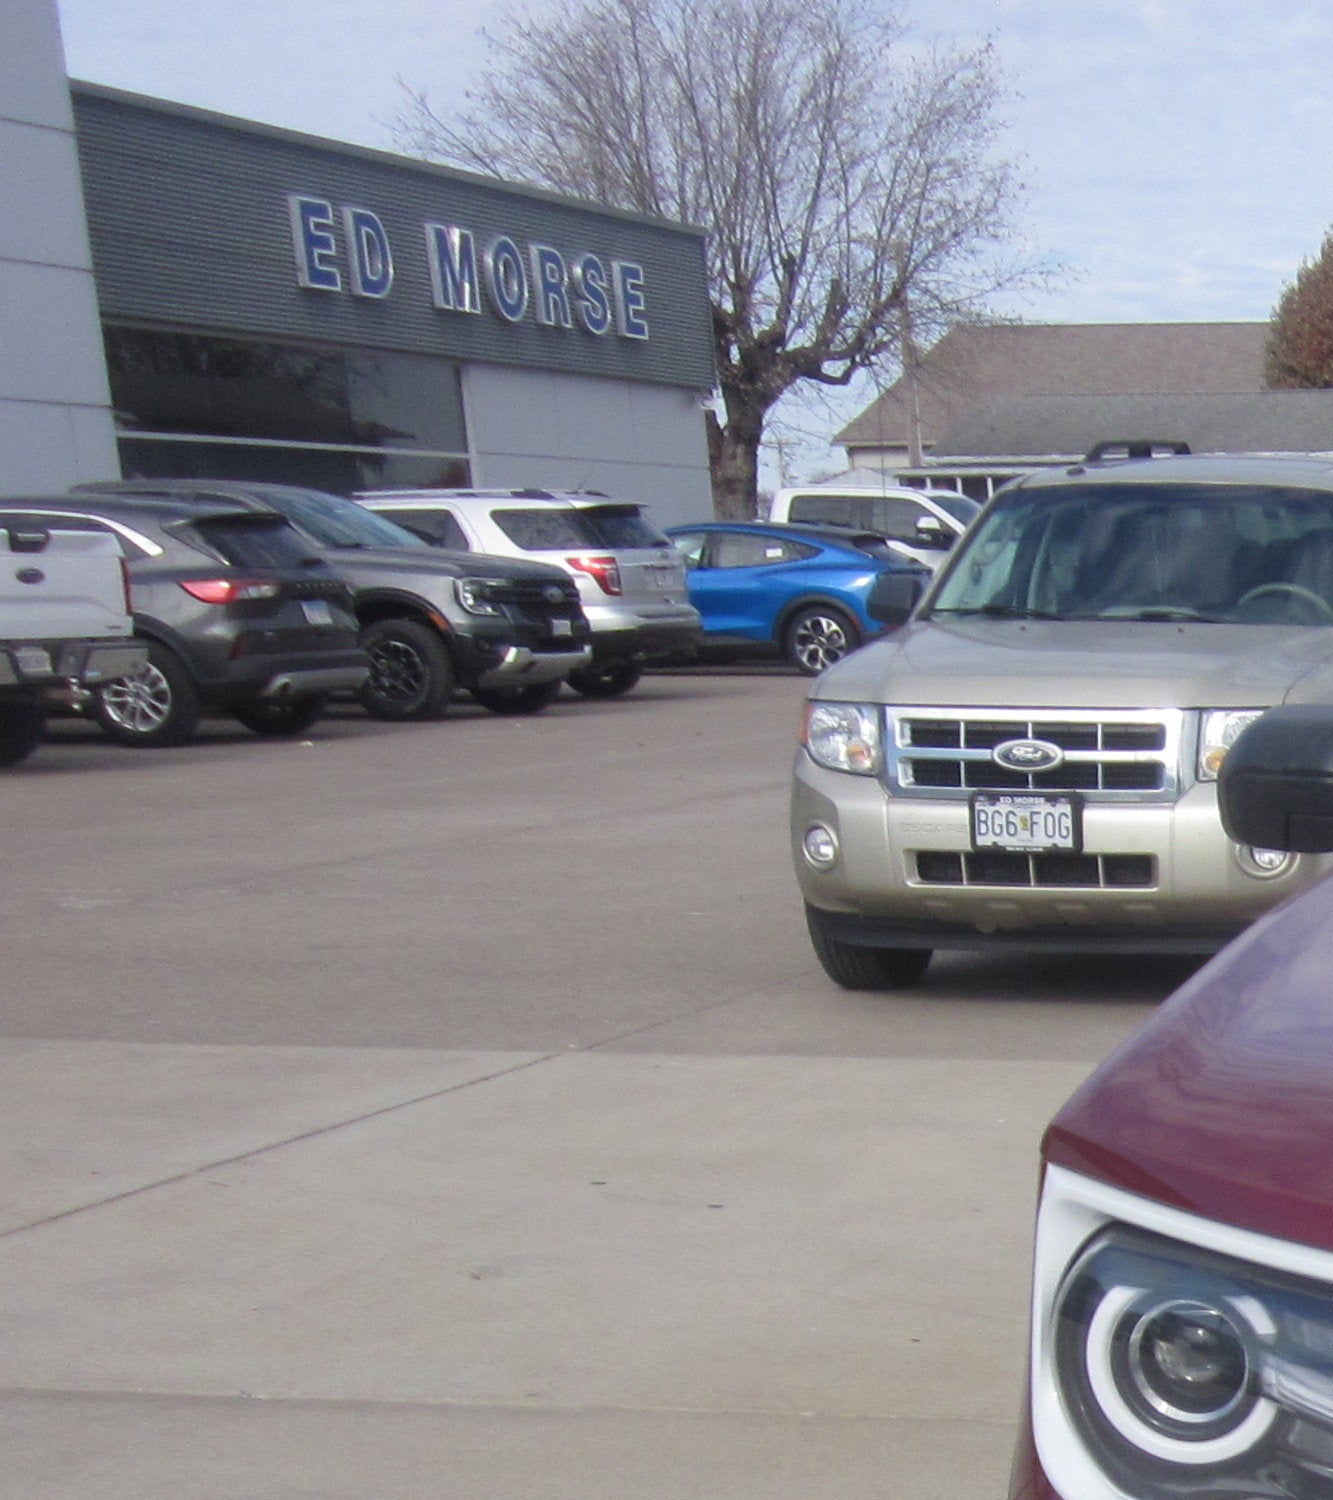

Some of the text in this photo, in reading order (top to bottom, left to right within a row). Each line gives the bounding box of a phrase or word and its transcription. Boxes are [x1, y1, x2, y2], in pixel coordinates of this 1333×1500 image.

[289, 195, 649, 341] ED MORSE
[1000, 796, 1046, 805] ED MORSE
[976, 808, 1018, 837] BG6
